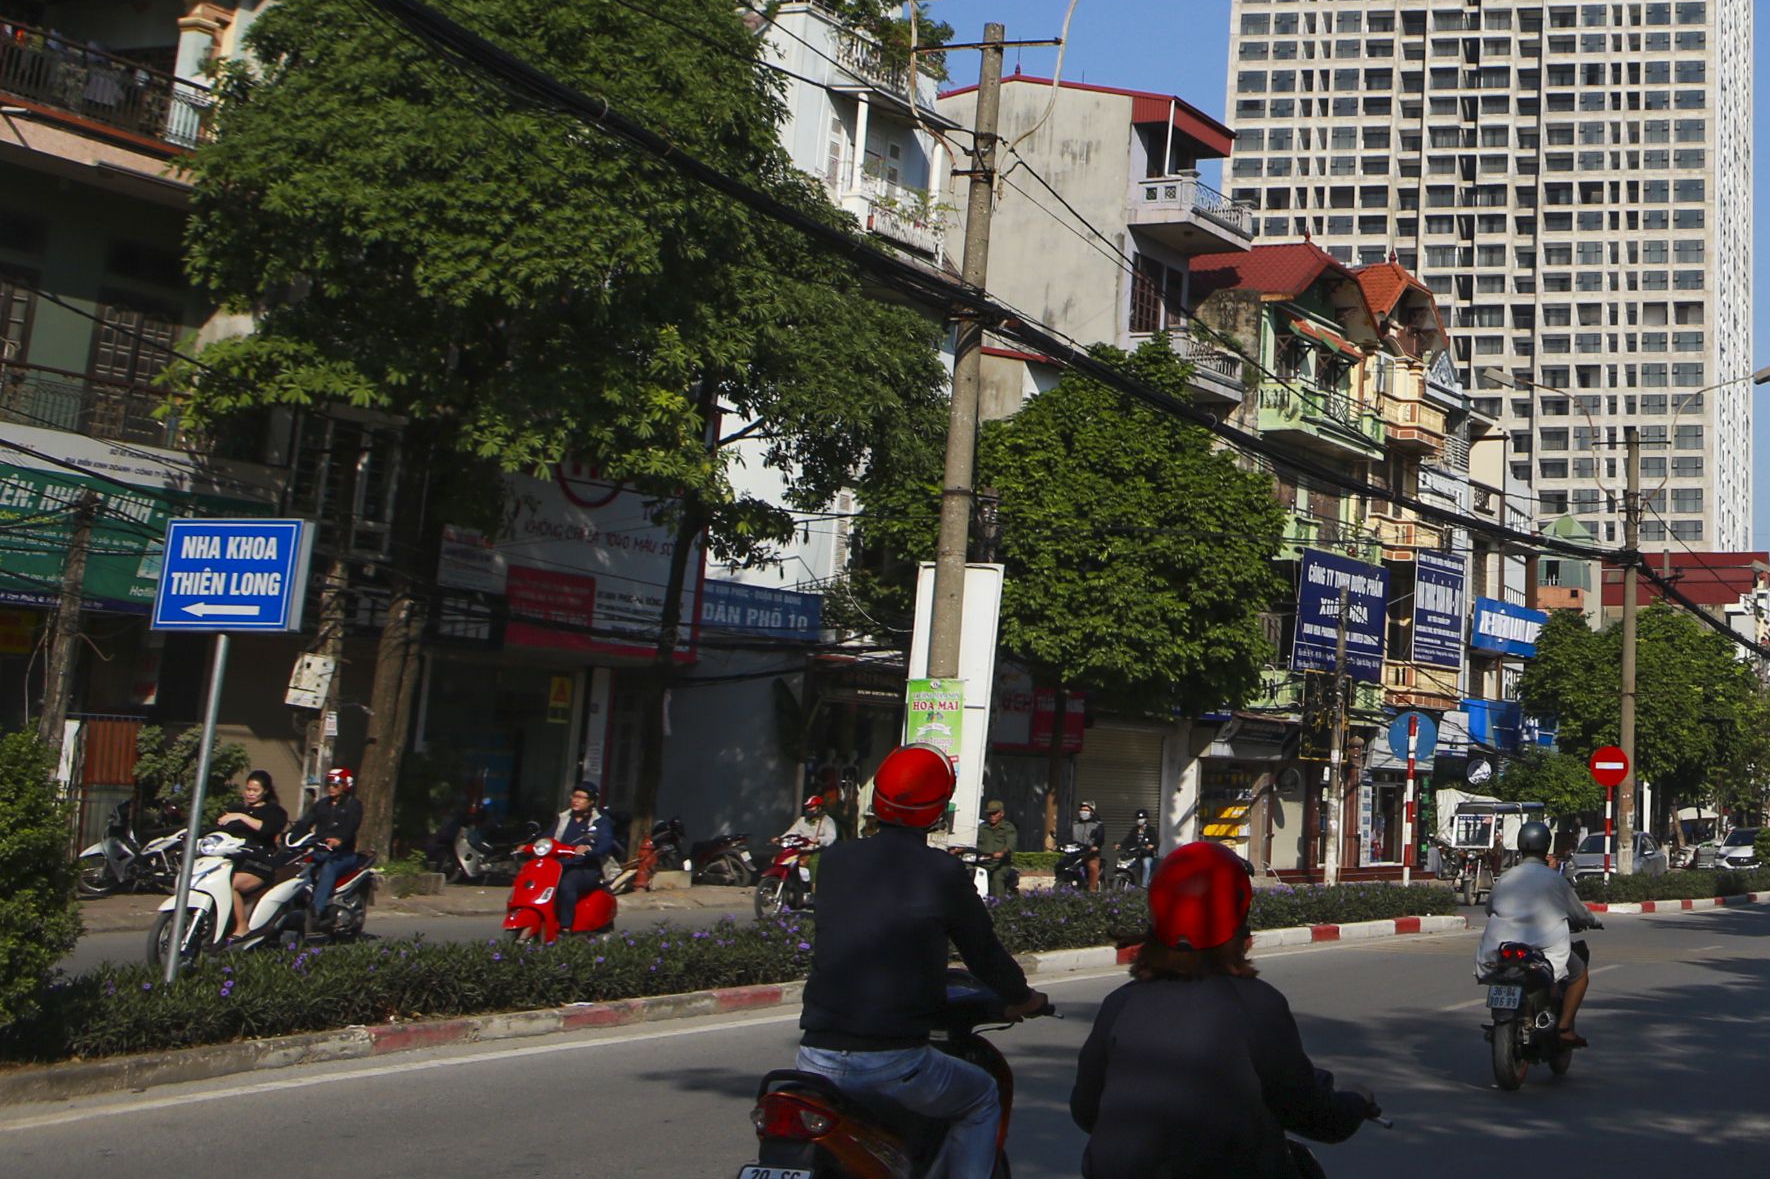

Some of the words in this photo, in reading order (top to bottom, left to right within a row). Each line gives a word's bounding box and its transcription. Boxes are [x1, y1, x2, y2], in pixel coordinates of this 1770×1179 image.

[181, 536, 221, 559] NHA
[226, 536, 278, 560] KHOA
[171, 567, 227, 595] THIÊN
[229, 572, 281, 596] LONG
[1308, 561, 1326, 586] CÔNG
[1326, 568, 1335, 587] TY
[702, 601, 741, 624] DÂN
[747, 608, 783, 628] PHỐ
[787, 614, 808, 632] 10
[912, 701, 935, 711] HOA
[938, 701, 959, 711] MAI
